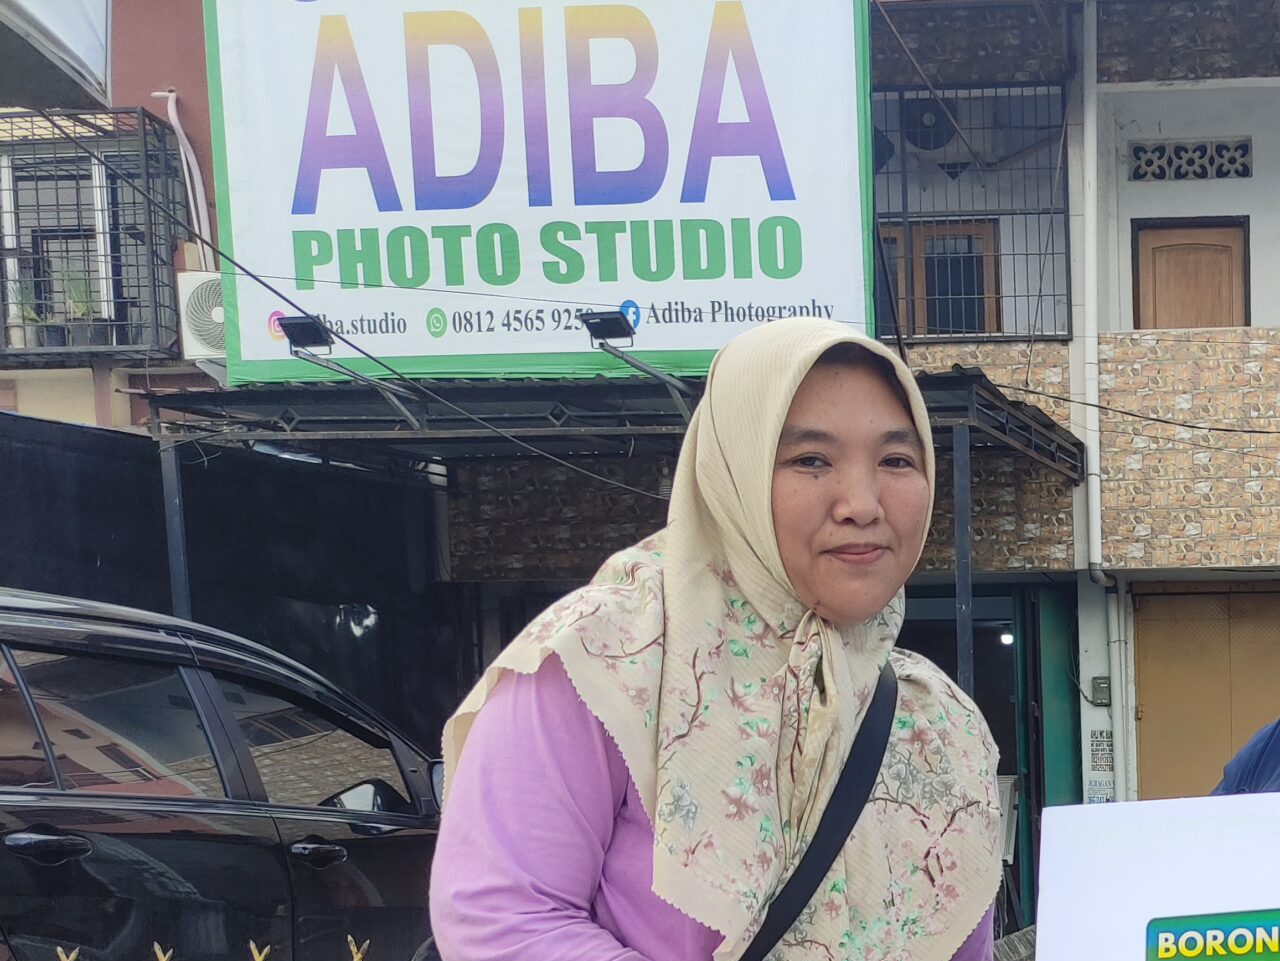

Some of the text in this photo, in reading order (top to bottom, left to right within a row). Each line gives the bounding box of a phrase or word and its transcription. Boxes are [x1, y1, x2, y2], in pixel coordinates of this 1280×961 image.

[291, 1, 797, 215] ADIBA
[291, 215, 802, 291] PHOTO STUDIO
[452, 307, 595, 334] 0812 4565 925
[646, 301, 704, 325] Adiba
